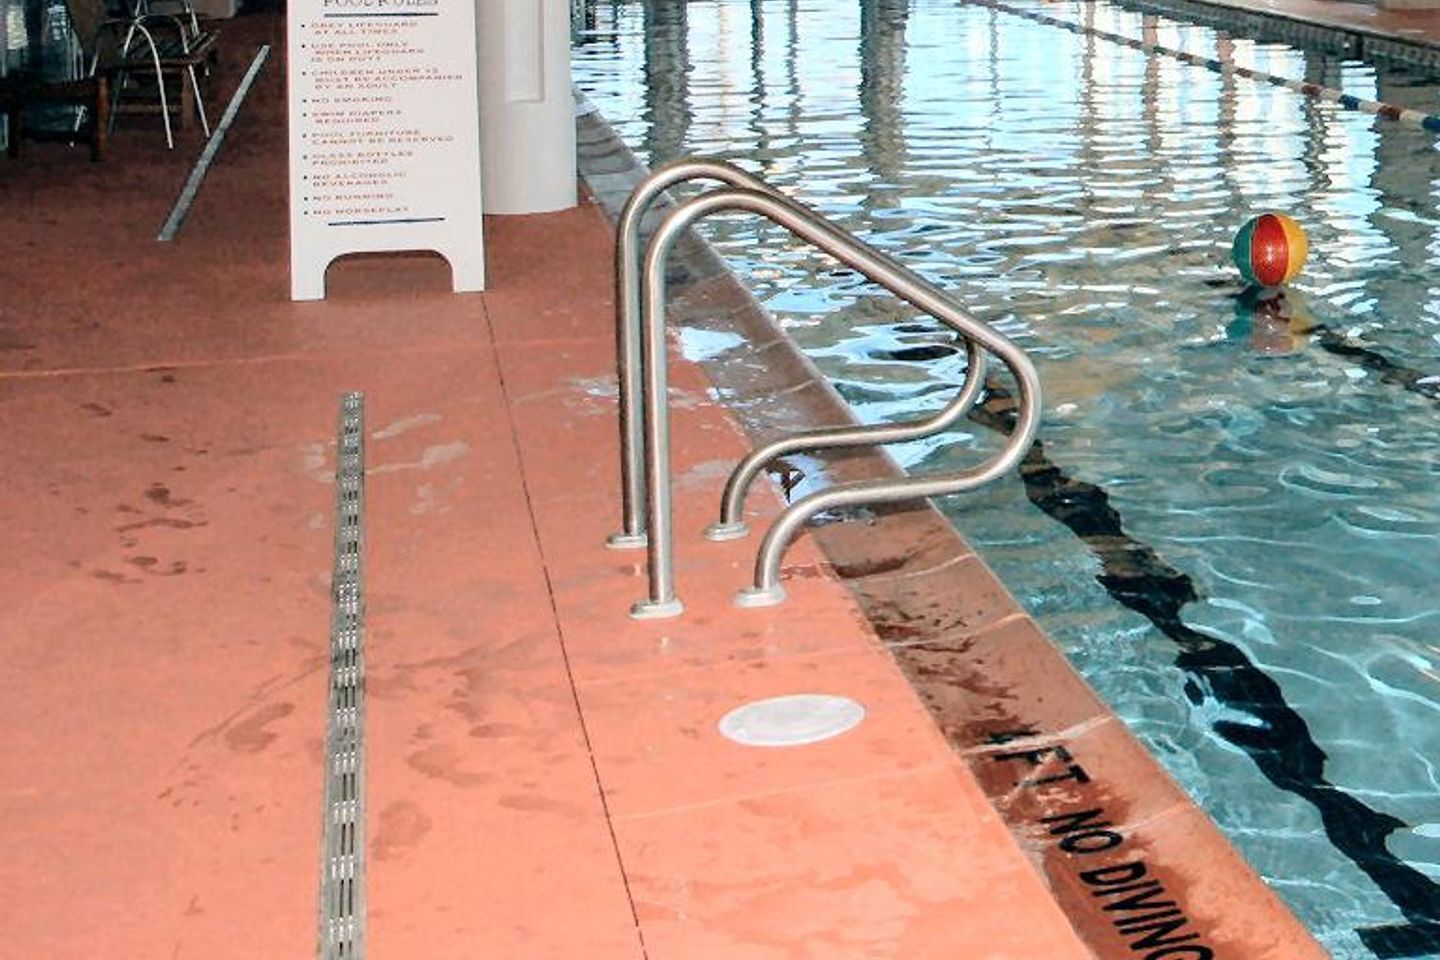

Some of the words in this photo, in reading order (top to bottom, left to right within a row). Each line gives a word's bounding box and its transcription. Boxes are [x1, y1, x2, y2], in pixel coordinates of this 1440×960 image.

[350, 129, 421, 137] FURNITURE
[388, 135, 454, 144] RESERVED
[312, 158, 389, 166] PROHIBITED
[335, 193, 393, 201] RUNNING
[335, 207, 408, 215] HORSEPLAY
[1038, 808, 1124, 854] NO
